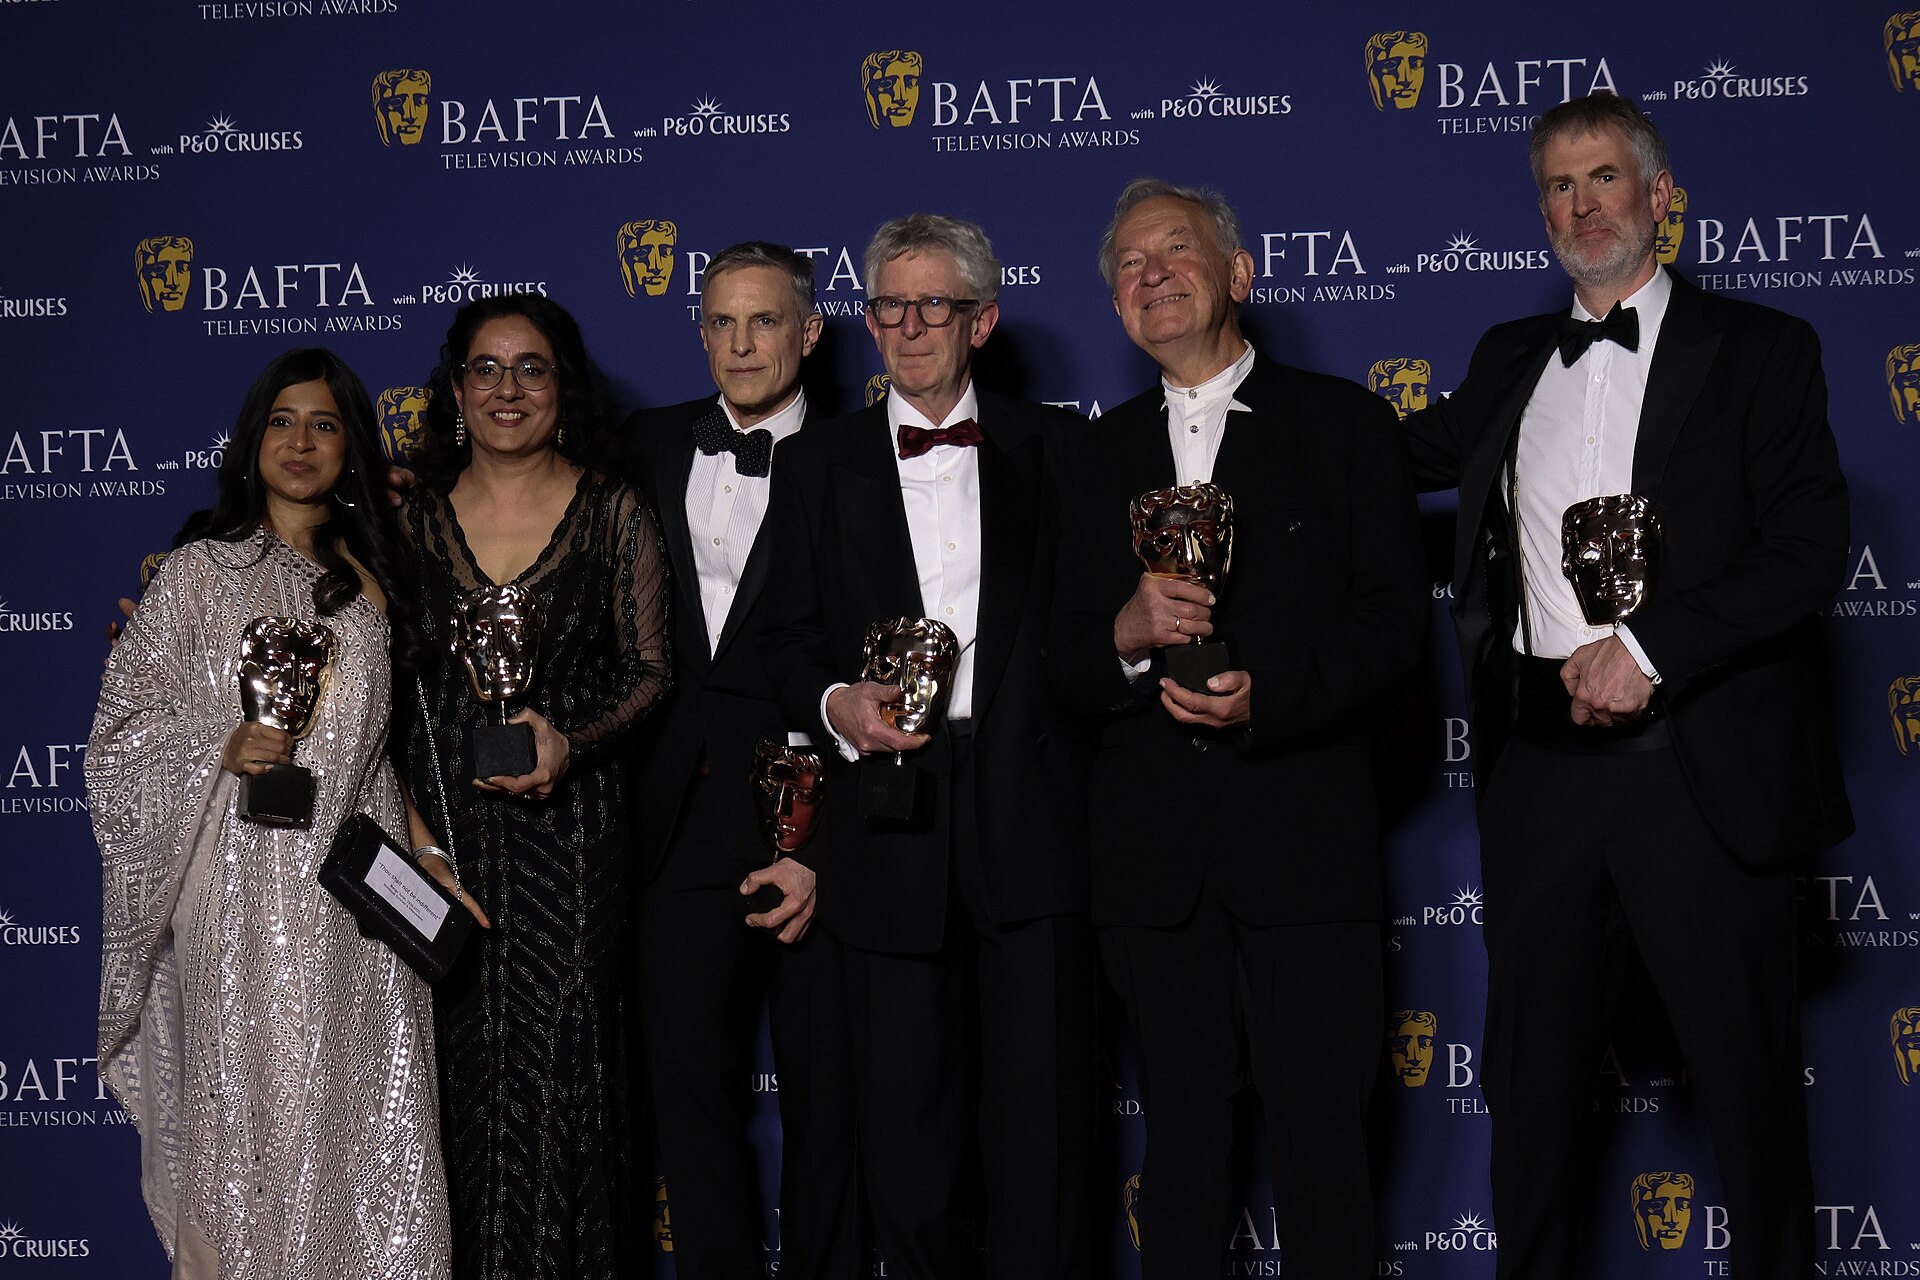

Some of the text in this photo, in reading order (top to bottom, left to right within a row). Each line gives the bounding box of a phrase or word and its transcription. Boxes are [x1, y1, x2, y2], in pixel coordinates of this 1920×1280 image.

[199, 0, 397, 19] TELEVISION AWARDS
[1438, 58, 1618, 108] BAFTA
[1642, 75, 1808, 100] with P&O CRUISES
[932, 76, 1111, 126] BAFTA
[1131, 95, 1291, 119] with P&O CRUISES
[441, 95, 615, 143] BAFTA
[634, 113, 789, 137] with P&O CRUISES
[151, 131, 302, 154] with P&O CRUISES
[933, 130, 1139, 151] TELEVISION AWARDS
[441, 148, 642, 169] TELEVISION AWARDS
[83, 166, 159, 181] AWARDS
[1698, 214, 1885, 263] BAFTA
[1253, 230, 1366, 277] FTA
[1386, 250, 1549, 273] with P&O CRUISES
[1002, 266, 1040, 285] ISES
[1698, 269, 1914, 289] TELEVISION AWARDS
[203, 263, 374, 310] BAFTA
[393, 295, 415, 304] with
[423, 285, 461, 303] P&O
[1313, 285, 1394, 301] AWARDS
[0, 296, 66, 317] RUISES
[203, 315, 401, 335] TELEVISION AWARDS
[157, 461, 178, 469] with
[89, 481, 164, 496] AWARDS
[1831, 600, 1916, 616] AWARDS
[1392, 916, 1416, 925] with
[1424, 907, 1464, 925] P&O
[3, 927, 79, 944] CRUISES
[1835, 931, 1918, 946] AWARDS
[12, 1240, 89, 1257] CRUISES
[1395, 1241, 1417, 1250] with
[1426, 1232, 1466, 1250] P&O
[1836, 1261, 1919, 1276] AWARDS
